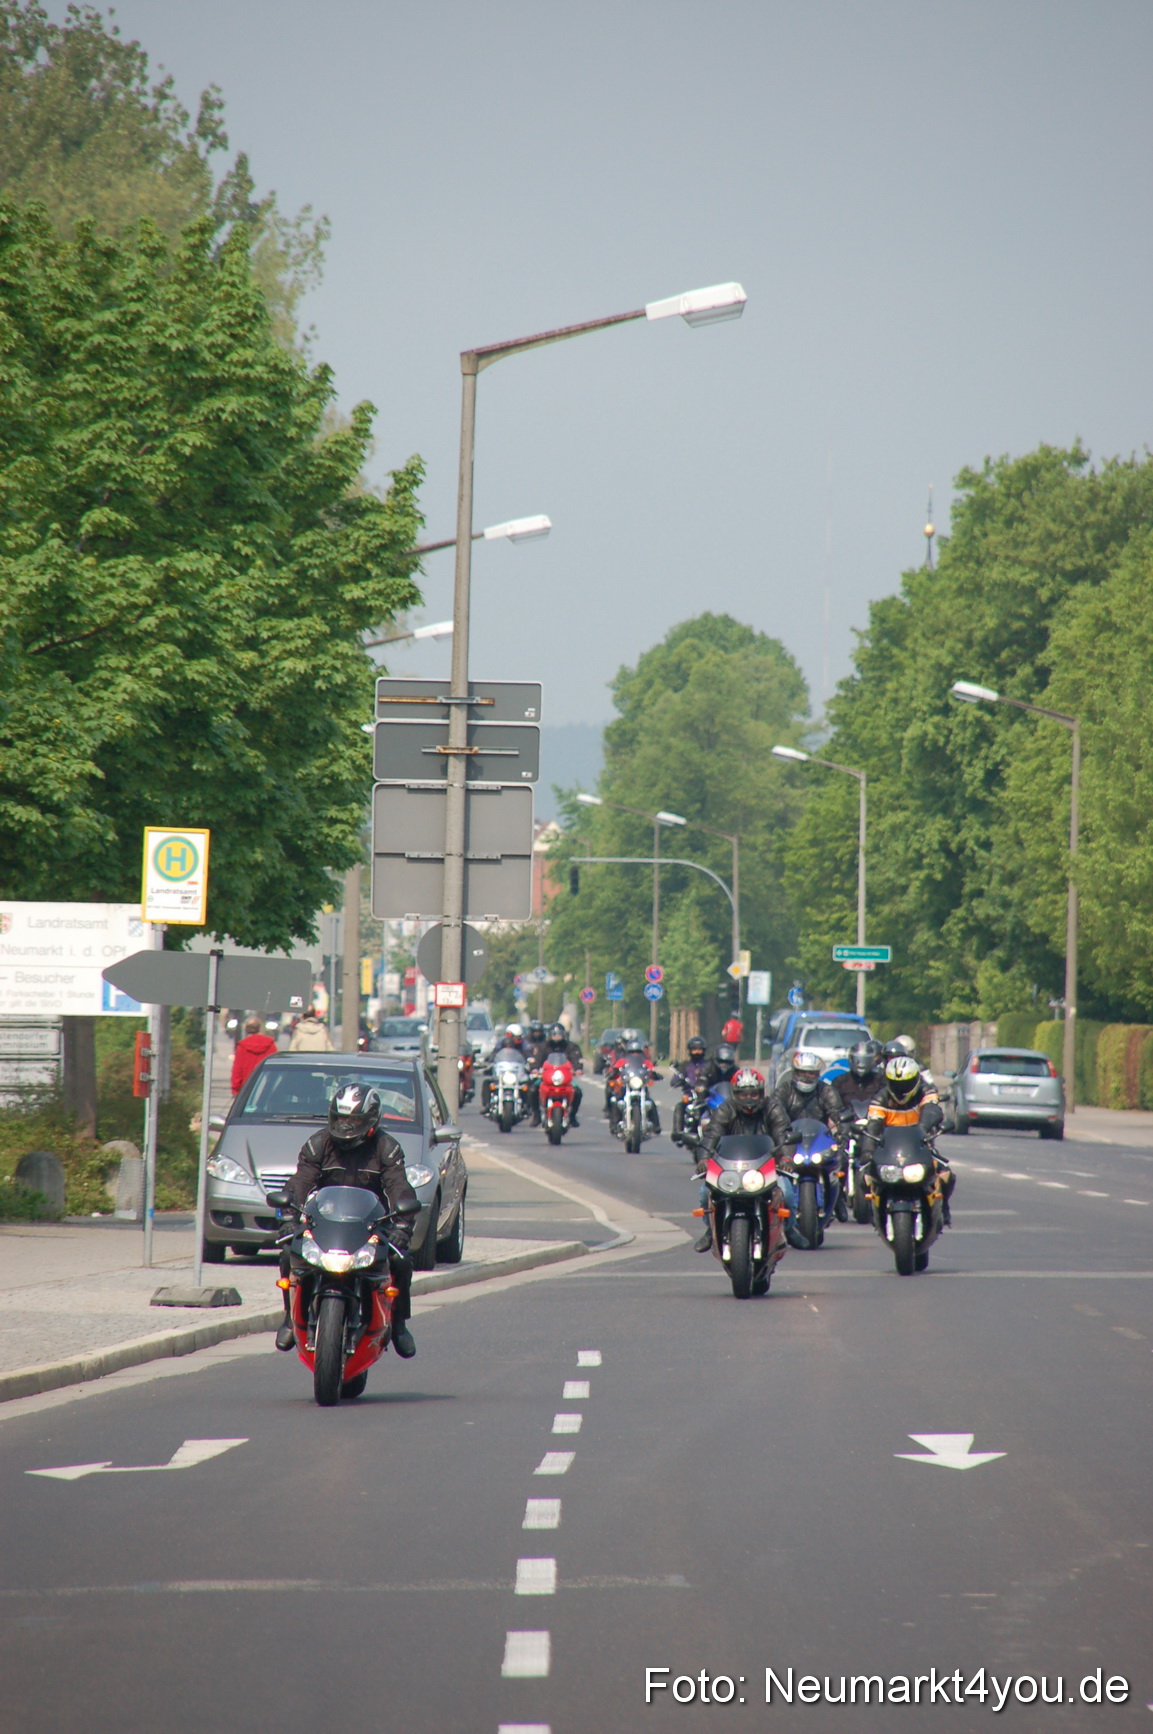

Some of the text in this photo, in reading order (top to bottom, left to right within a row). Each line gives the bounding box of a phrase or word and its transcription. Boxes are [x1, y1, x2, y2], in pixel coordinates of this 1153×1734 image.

[165, 847, 187, 872] H
[28, 916, 108, 929] Landratsamt
[1, 944, 63, 956] Neumarkt
[15, 971, 75, 984] Besucher
[67, 990, 95, 999] Stunde
